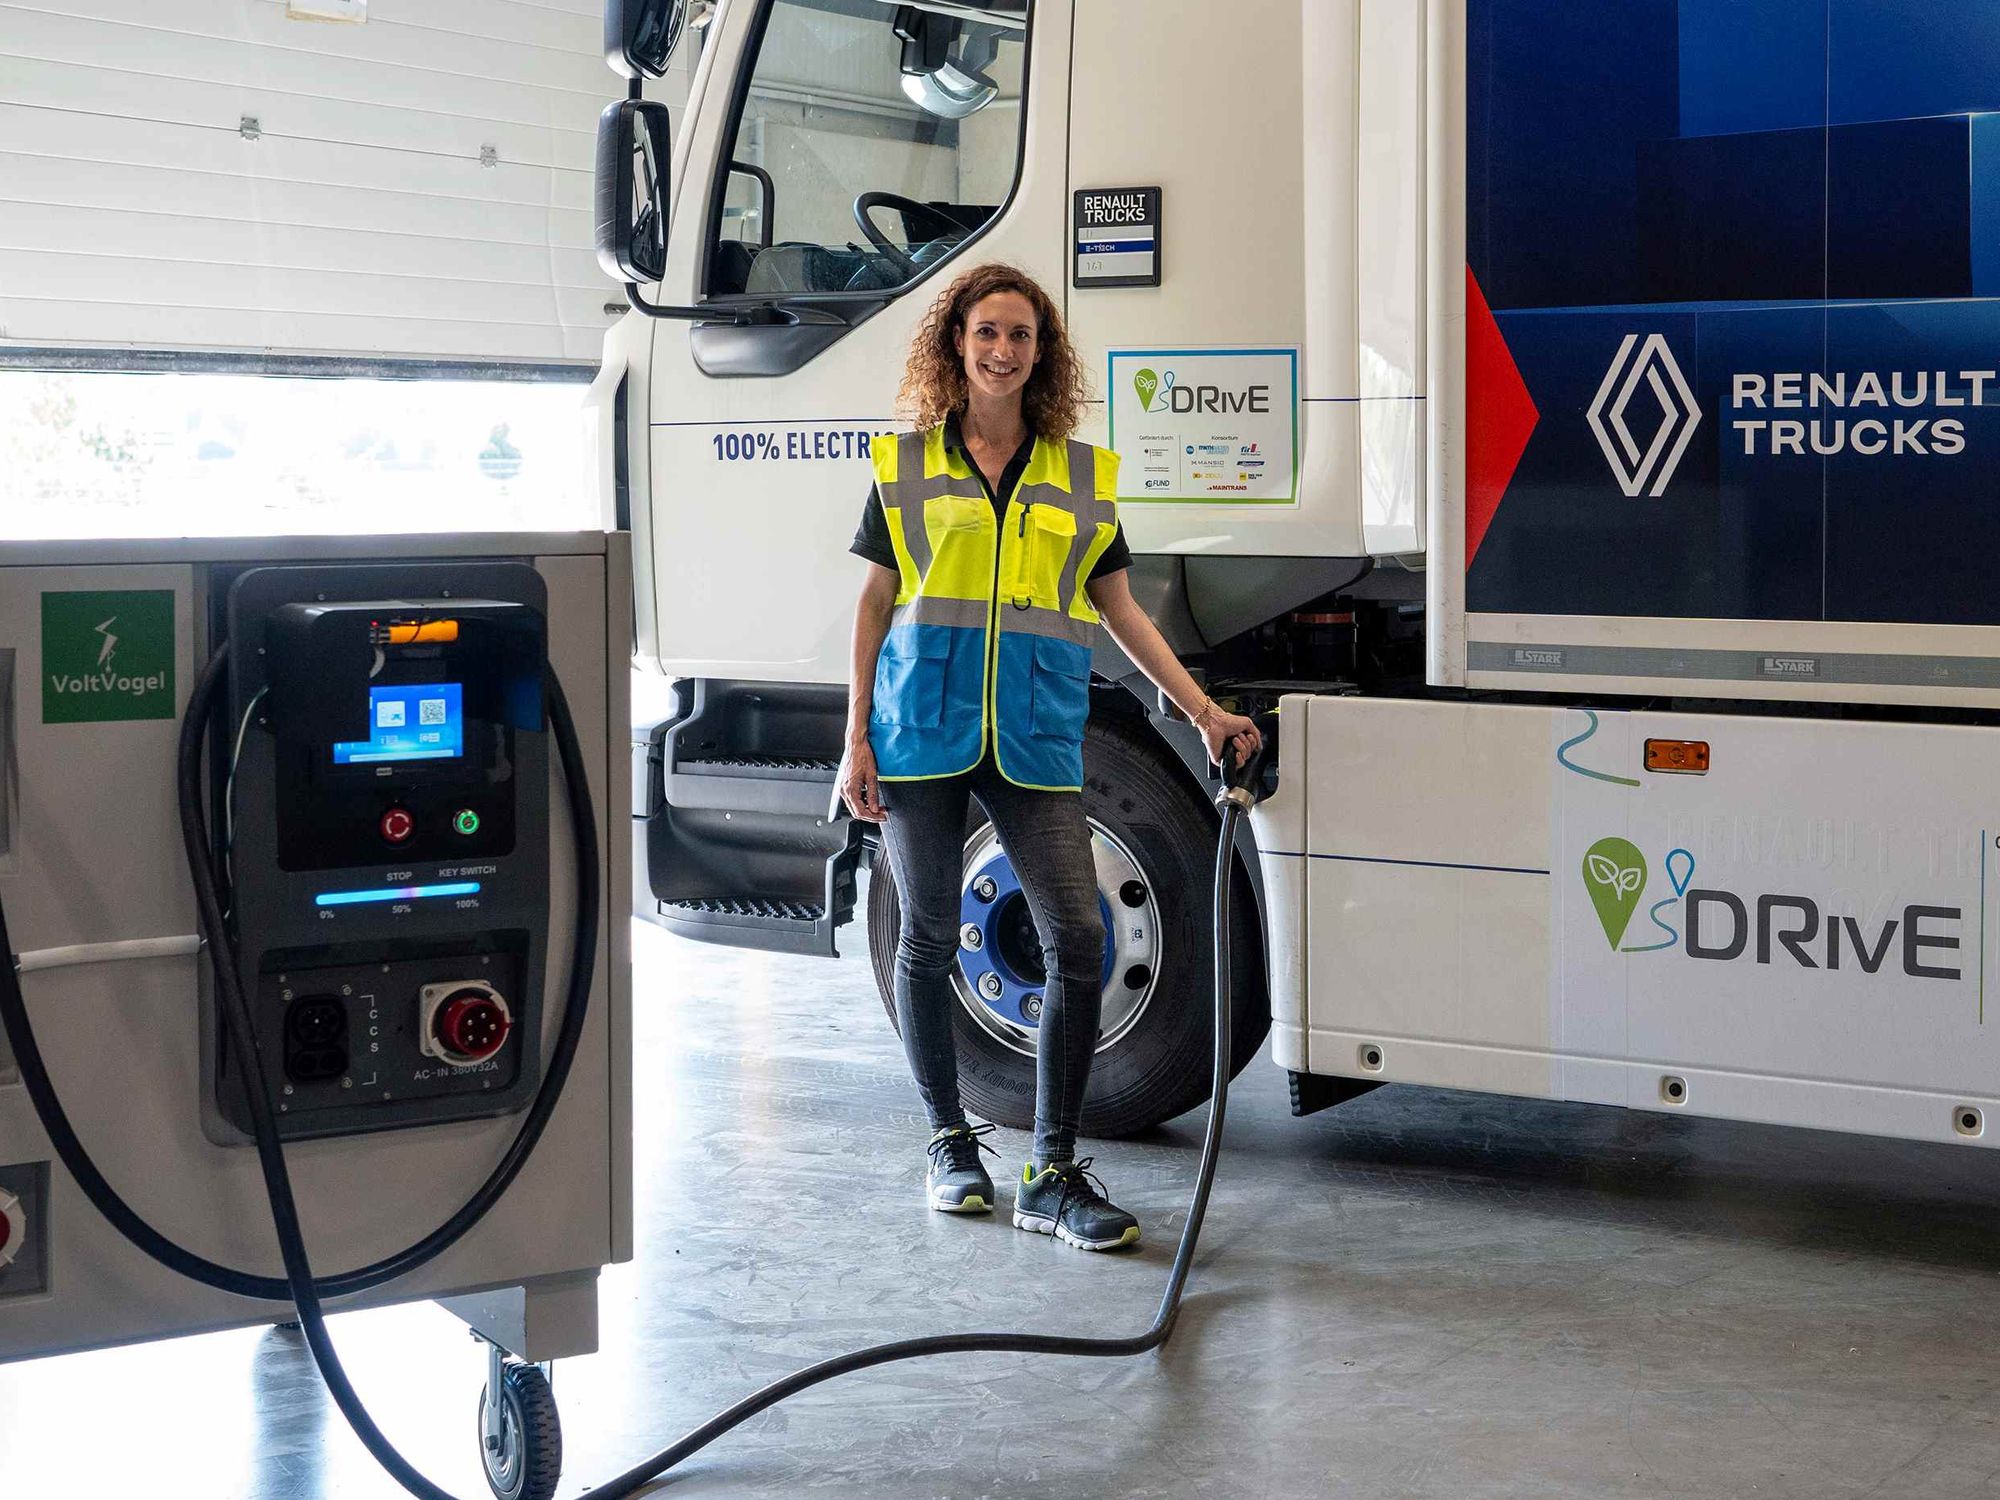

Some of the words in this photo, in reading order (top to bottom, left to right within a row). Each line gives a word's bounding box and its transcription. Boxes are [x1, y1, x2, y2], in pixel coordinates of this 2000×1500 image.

[1084, 194, 1146, 210] RENAULT
[1084, 208, 1146, 224] TRUCKS
[1733, 370, 1996, 408] RENAULT
[1733, 419, 1966, 455] TRUCKS
[713, 433, 780, 460] 100%
[787, 431, 895, 460] ELECTR
[52, 671, 165, 695] VoltVogel
[387, 872, 413, 881] STOP
[439, 868, 458, 878] KEY
[460, 865, 497, 877] SWITCH
[391, 904, 412, 914] 50%
[456, 899, 479, 909] 100%
[319, 910, 335, 919] 0%
[413, 1067, 449, 1081] AC-IN
